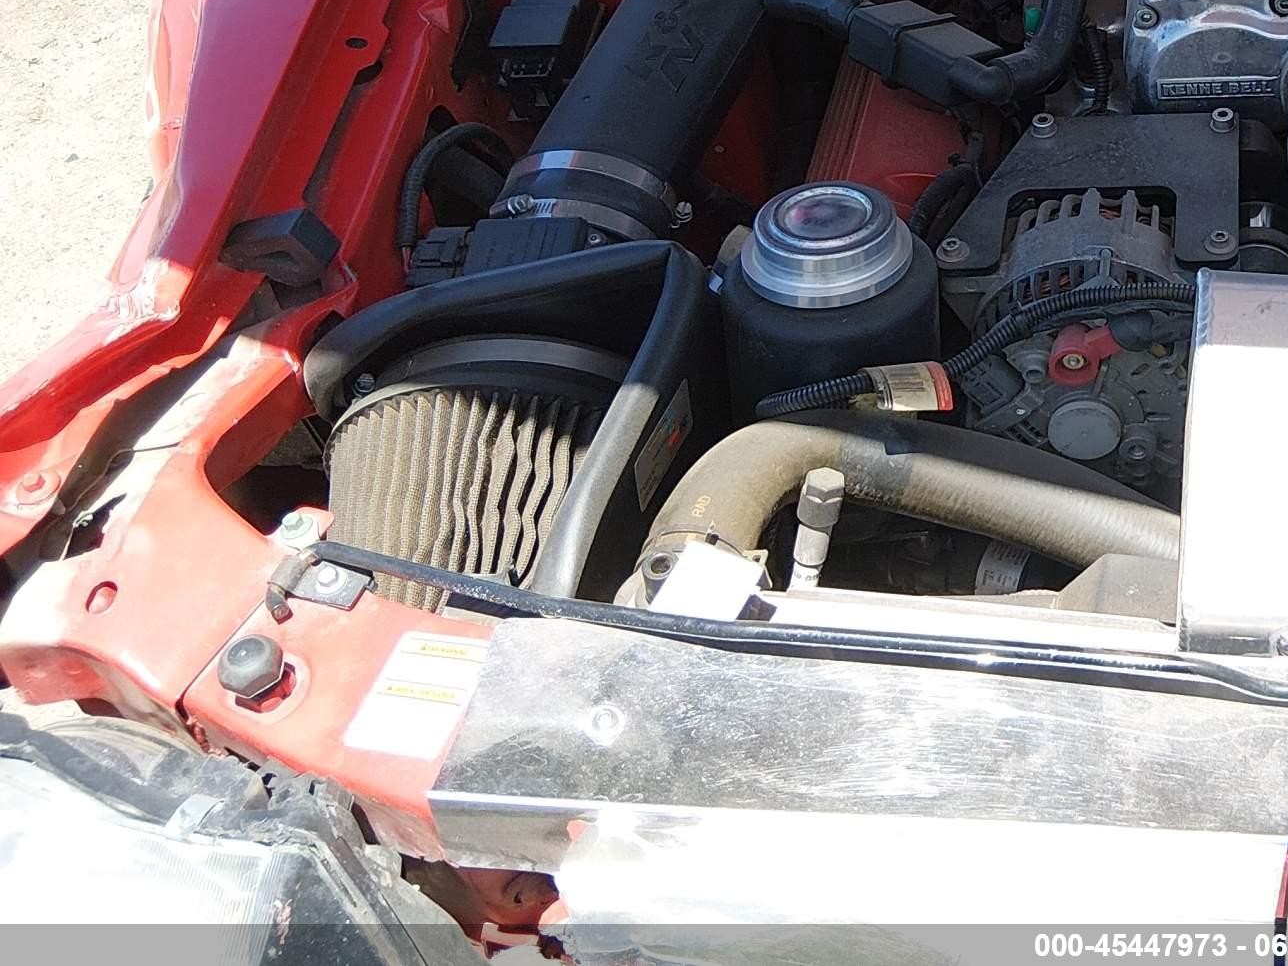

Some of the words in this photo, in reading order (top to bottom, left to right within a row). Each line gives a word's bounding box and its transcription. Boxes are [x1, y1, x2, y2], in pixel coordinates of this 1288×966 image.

[1162, 83, 1222, 96] KENNE
[1228, 81, 1272, 94] BELL
[691, 495, 712, 518] RAD
